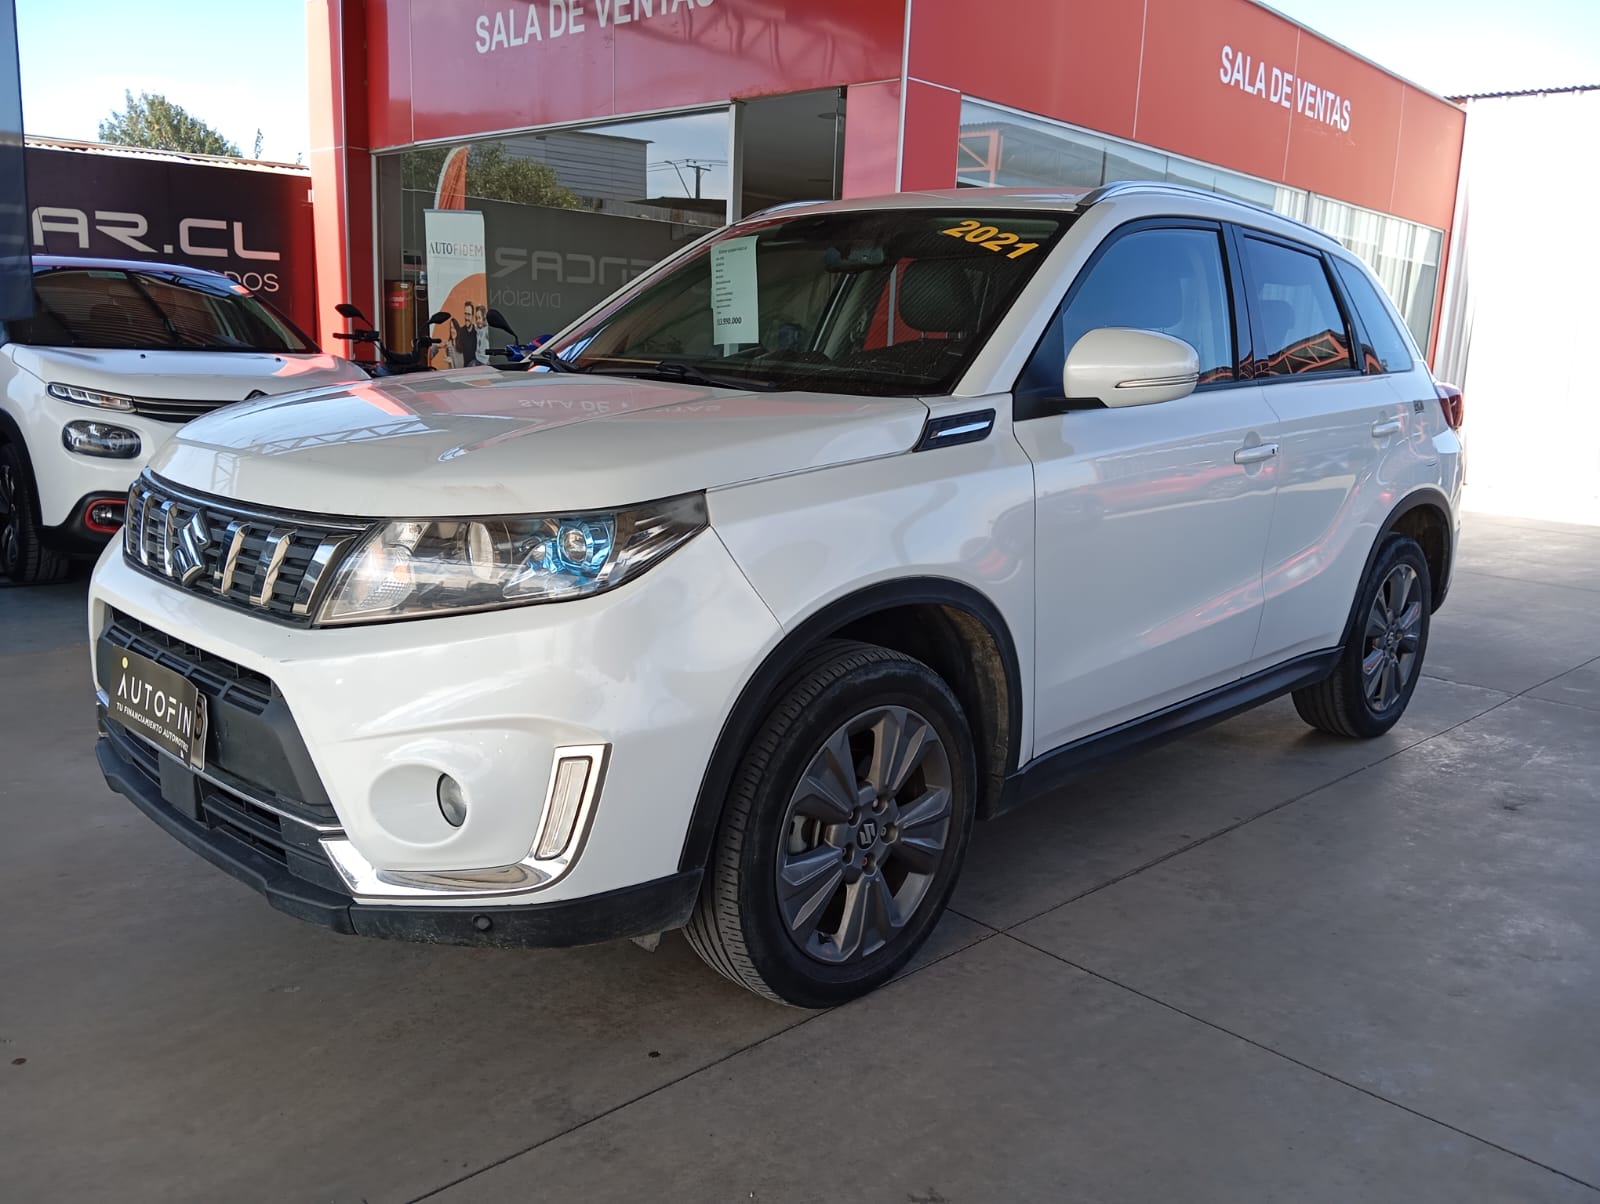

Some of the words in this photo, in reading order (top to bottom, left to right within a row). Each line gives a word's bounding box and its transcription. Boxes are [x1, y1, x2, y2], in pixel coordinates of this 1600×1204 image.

[475, 3, 542, 54] SALA
[549, 0, 585, 39] DE
[594, 0, 715, 28] VEN
[1219, 45, 1266, 99] SALA
[1269, 66, 1294, 109] DE
[1296, 77, 1351, 133] VENTAS
[942, 220, 1040, 260] 2021
[117, 673, 192, 738] AUTOFIN
